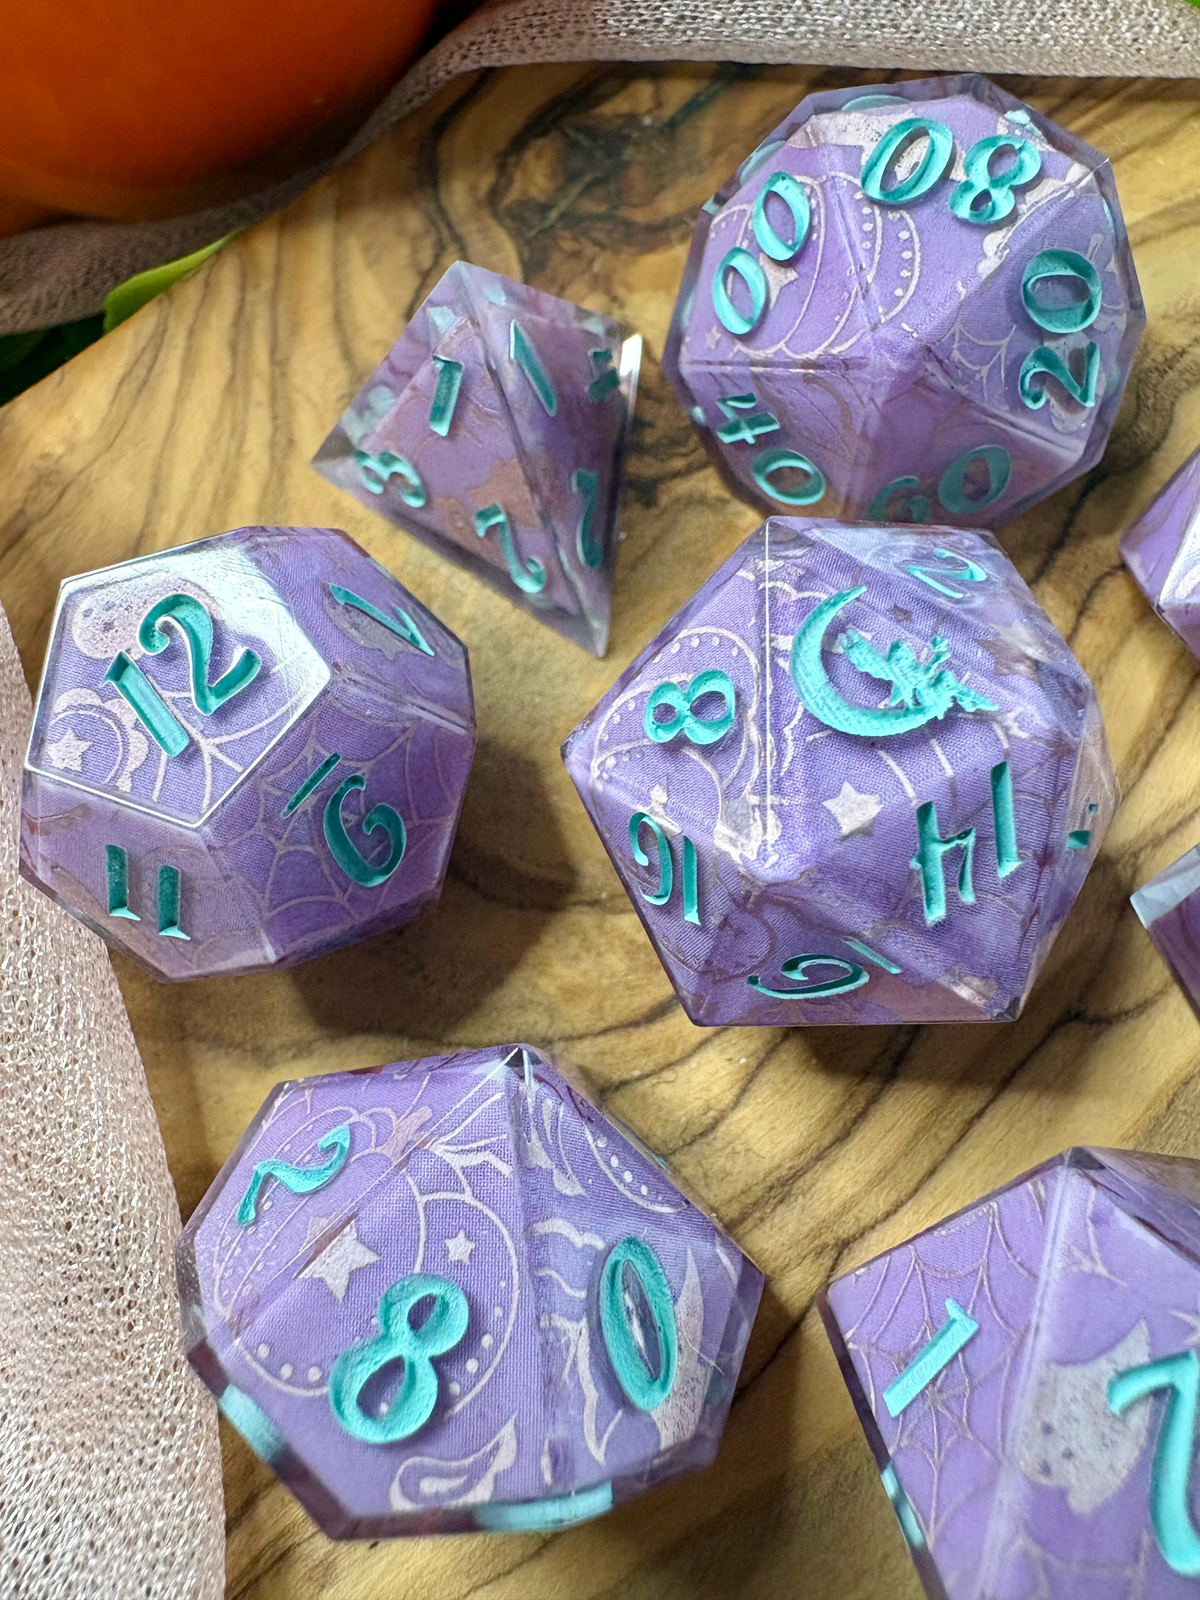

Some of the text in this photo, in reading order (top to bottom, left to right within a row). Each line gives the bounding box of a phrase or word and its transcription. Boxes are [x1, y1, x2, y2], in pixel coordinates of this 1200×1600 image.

[862, 118, 1042, 223] 80
[712, 171, 811, 334] 00
[1019, 249, 1103, 409] 20
[432, 355, 463, 437] 1
[715, 393, 826, 506] 40
[353, 450, 426, 507] 3
[106, 593, 261, 757] 12
[644, 670, 735, 745] 8
[105, 844, 191, 940] 11
[912, 762, 1022, 926] 14
[328, 1272, 469, 1444] 8
[601, 1236, 679, 1411] 0
[882, 1297, 980, 1418] 1
